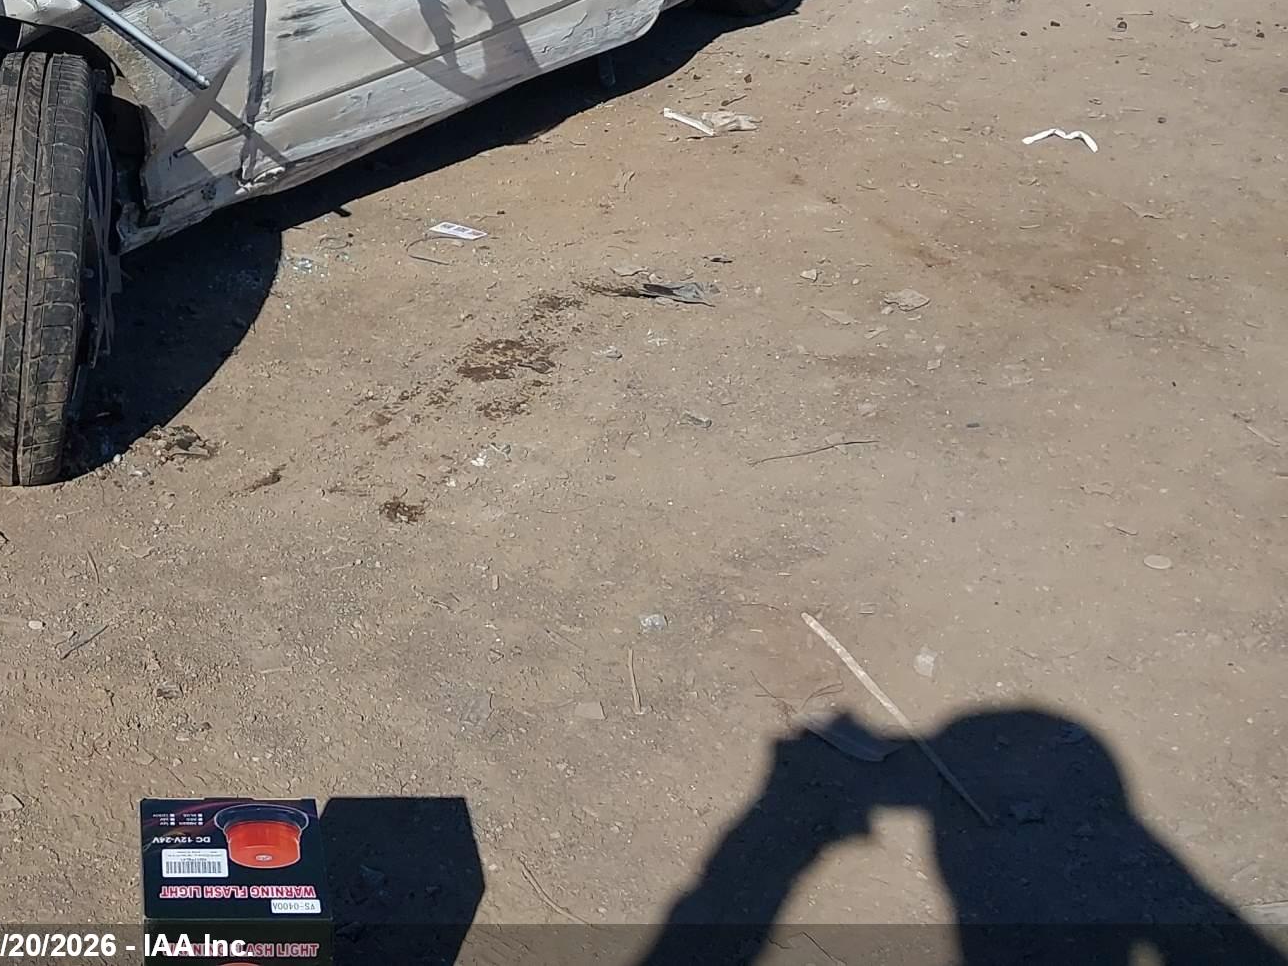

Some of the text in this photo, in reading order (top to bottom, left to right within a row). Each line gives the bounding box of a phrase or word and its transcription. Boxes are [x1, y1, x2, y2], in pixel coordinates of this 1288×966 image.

[195, 836, 211, 844] DC
[159, 886, 316, 899] WARNING FLASH LIGHT
[276, 943, 319, 957] LIGHT
